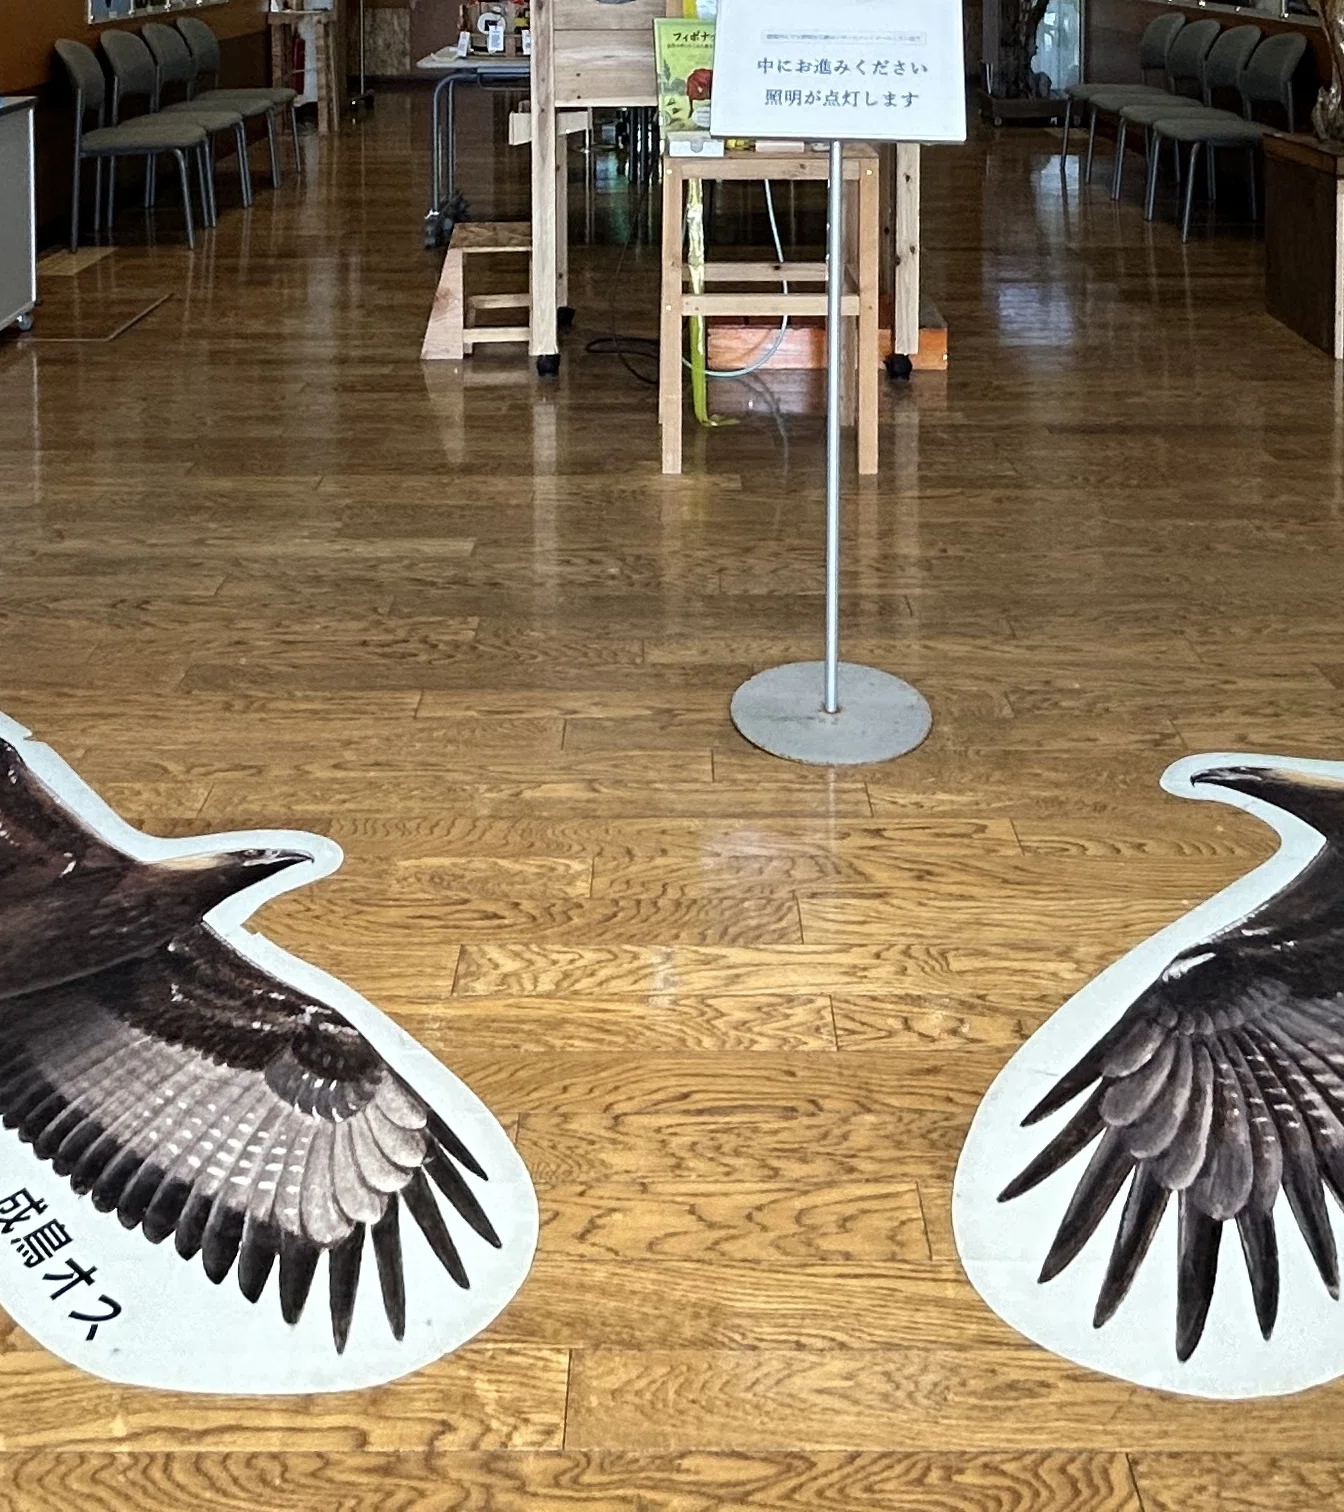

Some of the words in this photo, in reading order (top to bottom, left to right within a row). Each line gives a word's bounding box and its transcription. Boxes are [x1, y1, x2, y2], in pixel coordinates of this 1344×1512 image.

[757, 58, 928, 76] 中にお進みください
[765, 89, 919, 108] 照明が点灯します
